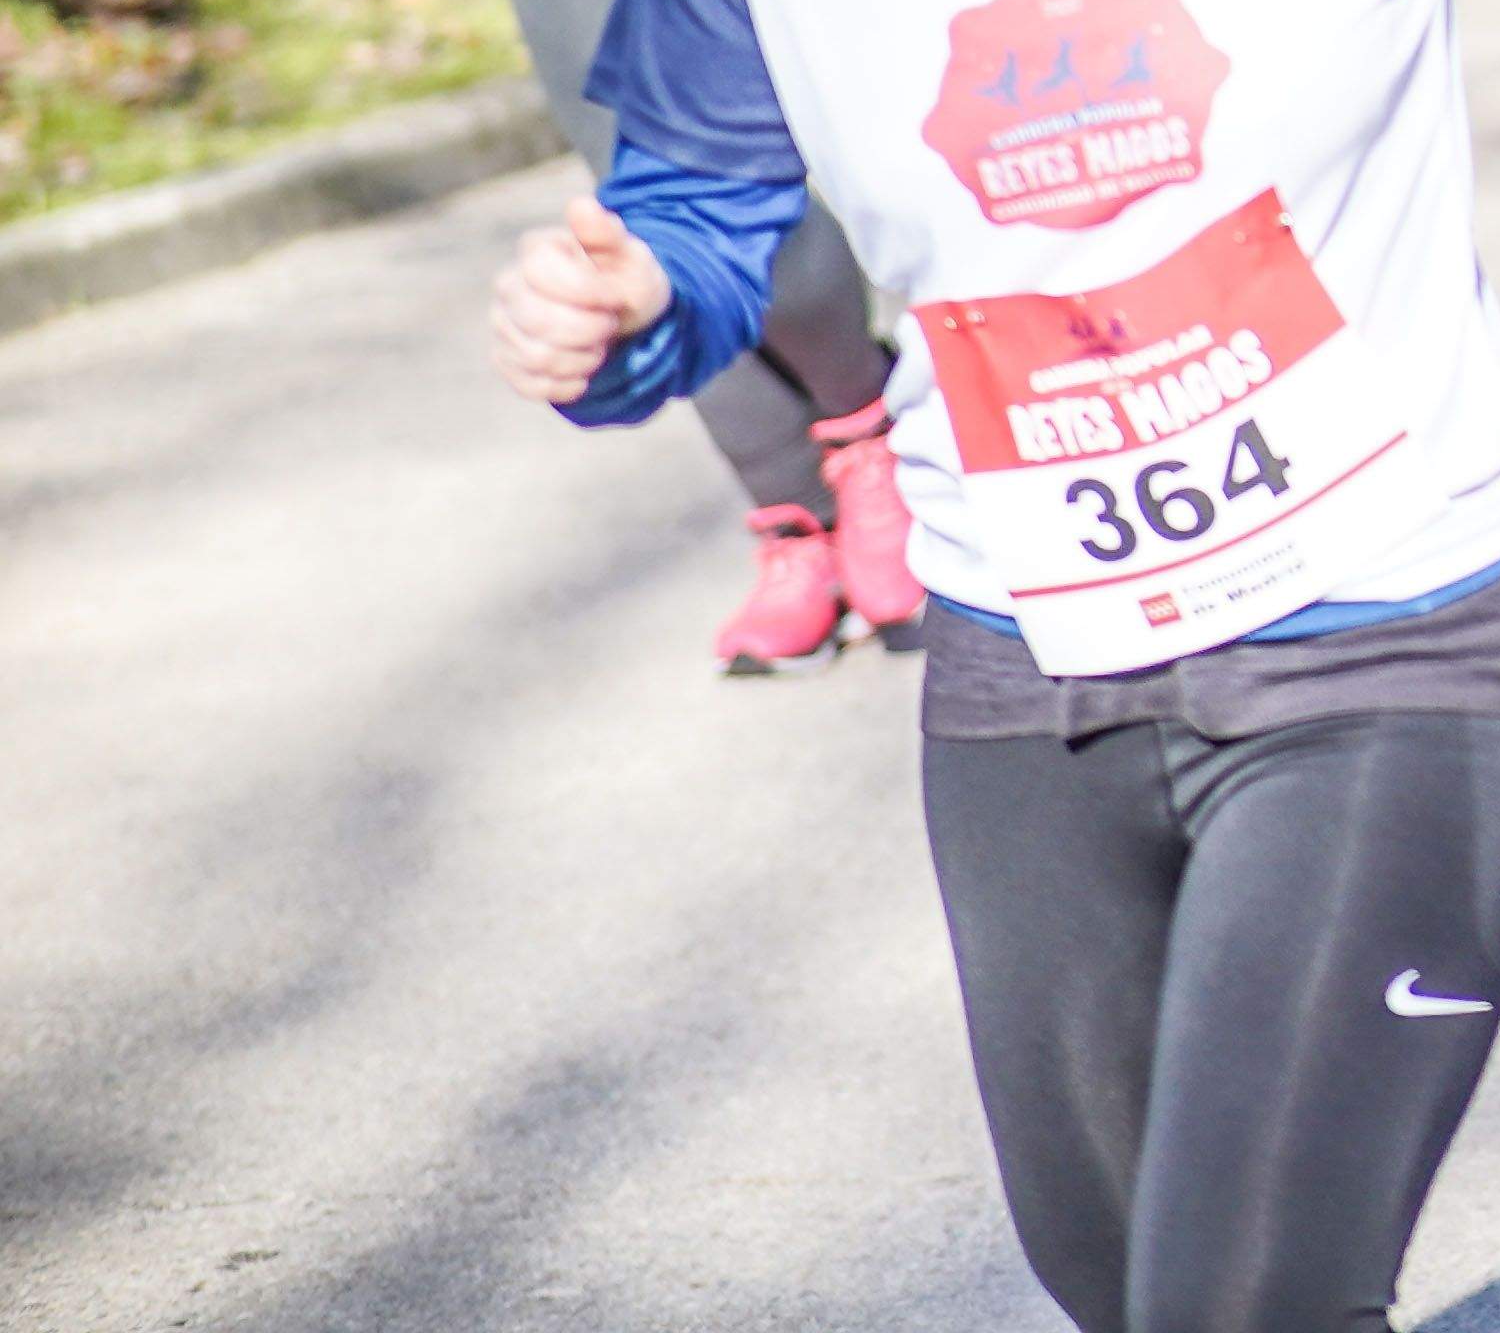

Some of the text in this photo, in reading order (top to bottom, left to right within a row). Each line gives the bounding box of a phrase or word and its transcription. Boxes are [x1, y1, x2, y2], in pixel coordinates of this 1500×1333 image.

[977, 116, 1192, 199] REYES MAGOS
[1006, 329, 1273, 462] REYES MAGOS
[1066, 418, 1290, 561] 364
